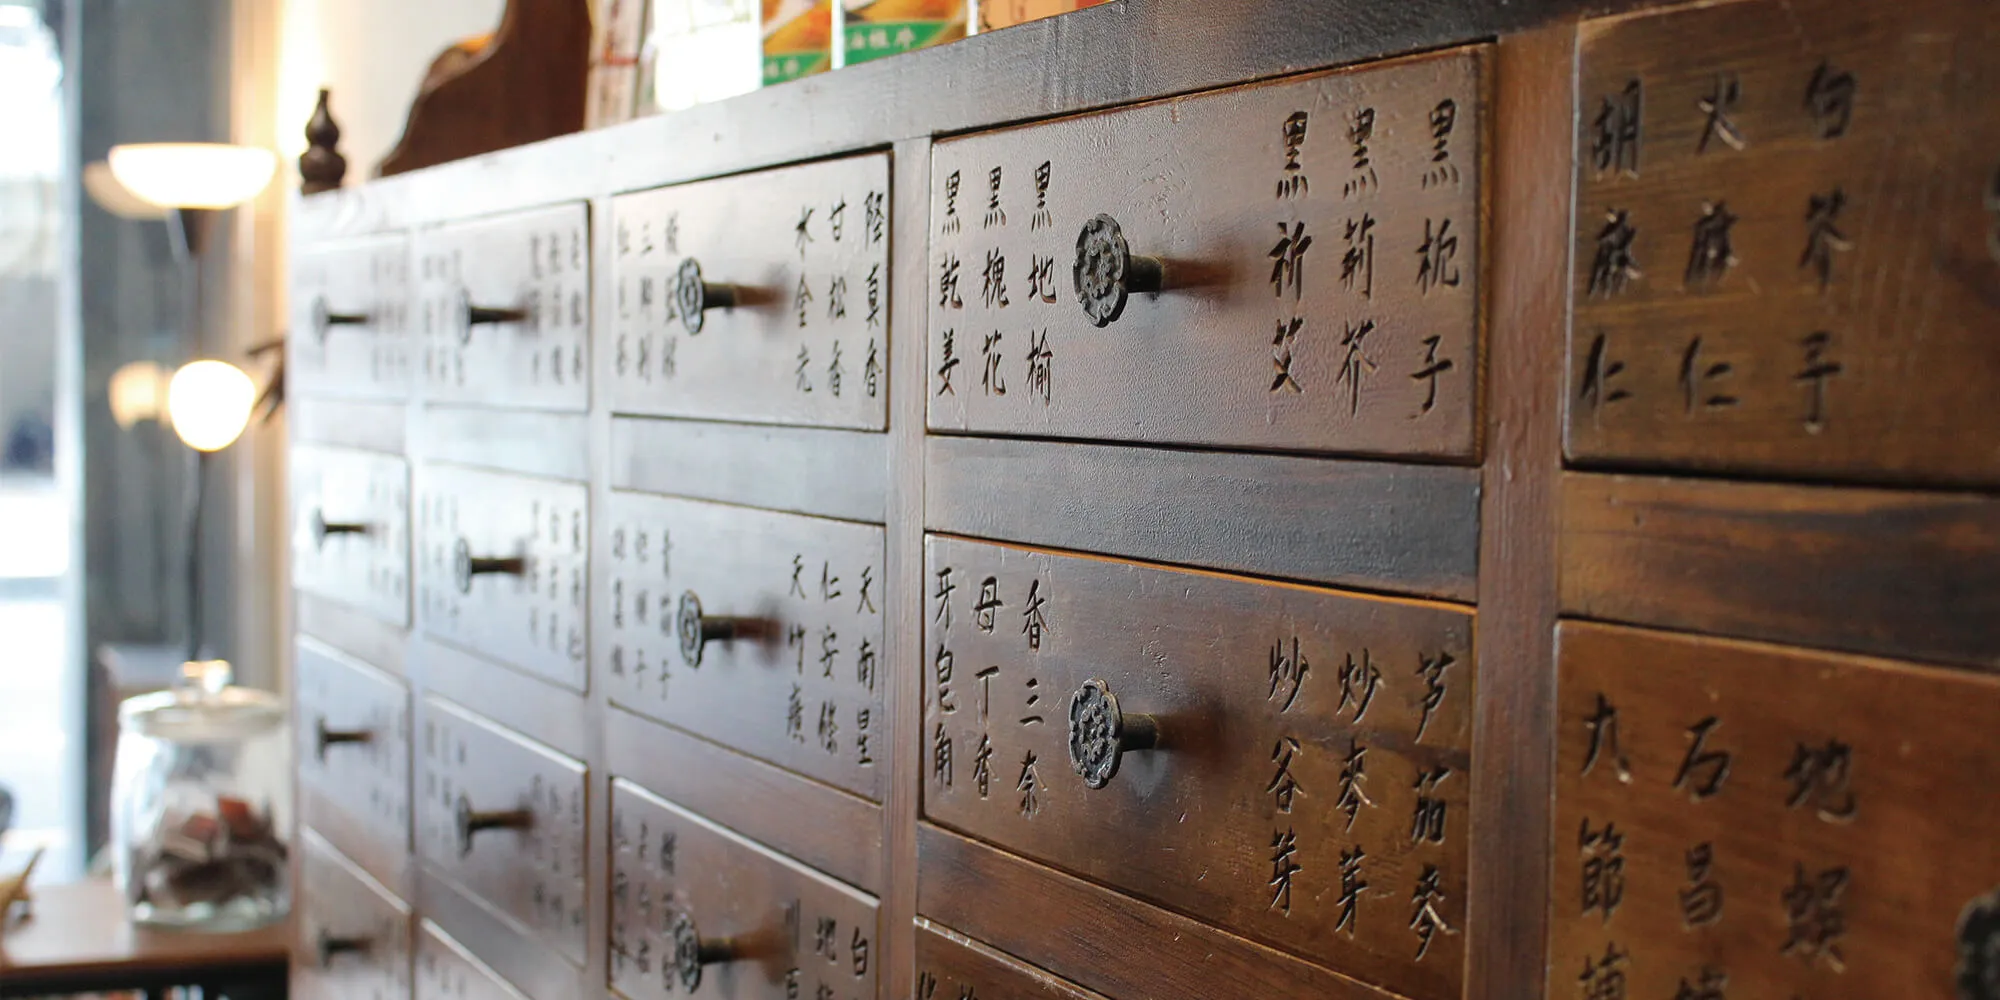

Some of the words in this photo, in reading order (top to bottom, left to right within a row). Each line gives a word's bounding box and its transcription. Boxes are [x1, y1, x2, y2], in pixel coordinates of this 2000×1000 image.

[827, 194, 848, 398] 甘松香
[981, 166, 1009, 396] 黑槐花
[1027, 160, 1056, 408] 黑地榆
[1580, 76, 1643, 424] 胡麻仁
[1678, 69, 1746, 423] 火麻仁
[857, 566, 877, 765] 天南星
[972, 575, 1003, 800] 母丁香
[1016, 578, 1050, 820] 香三奈
[1267, 637, 1313, 918] 炒谷芽
